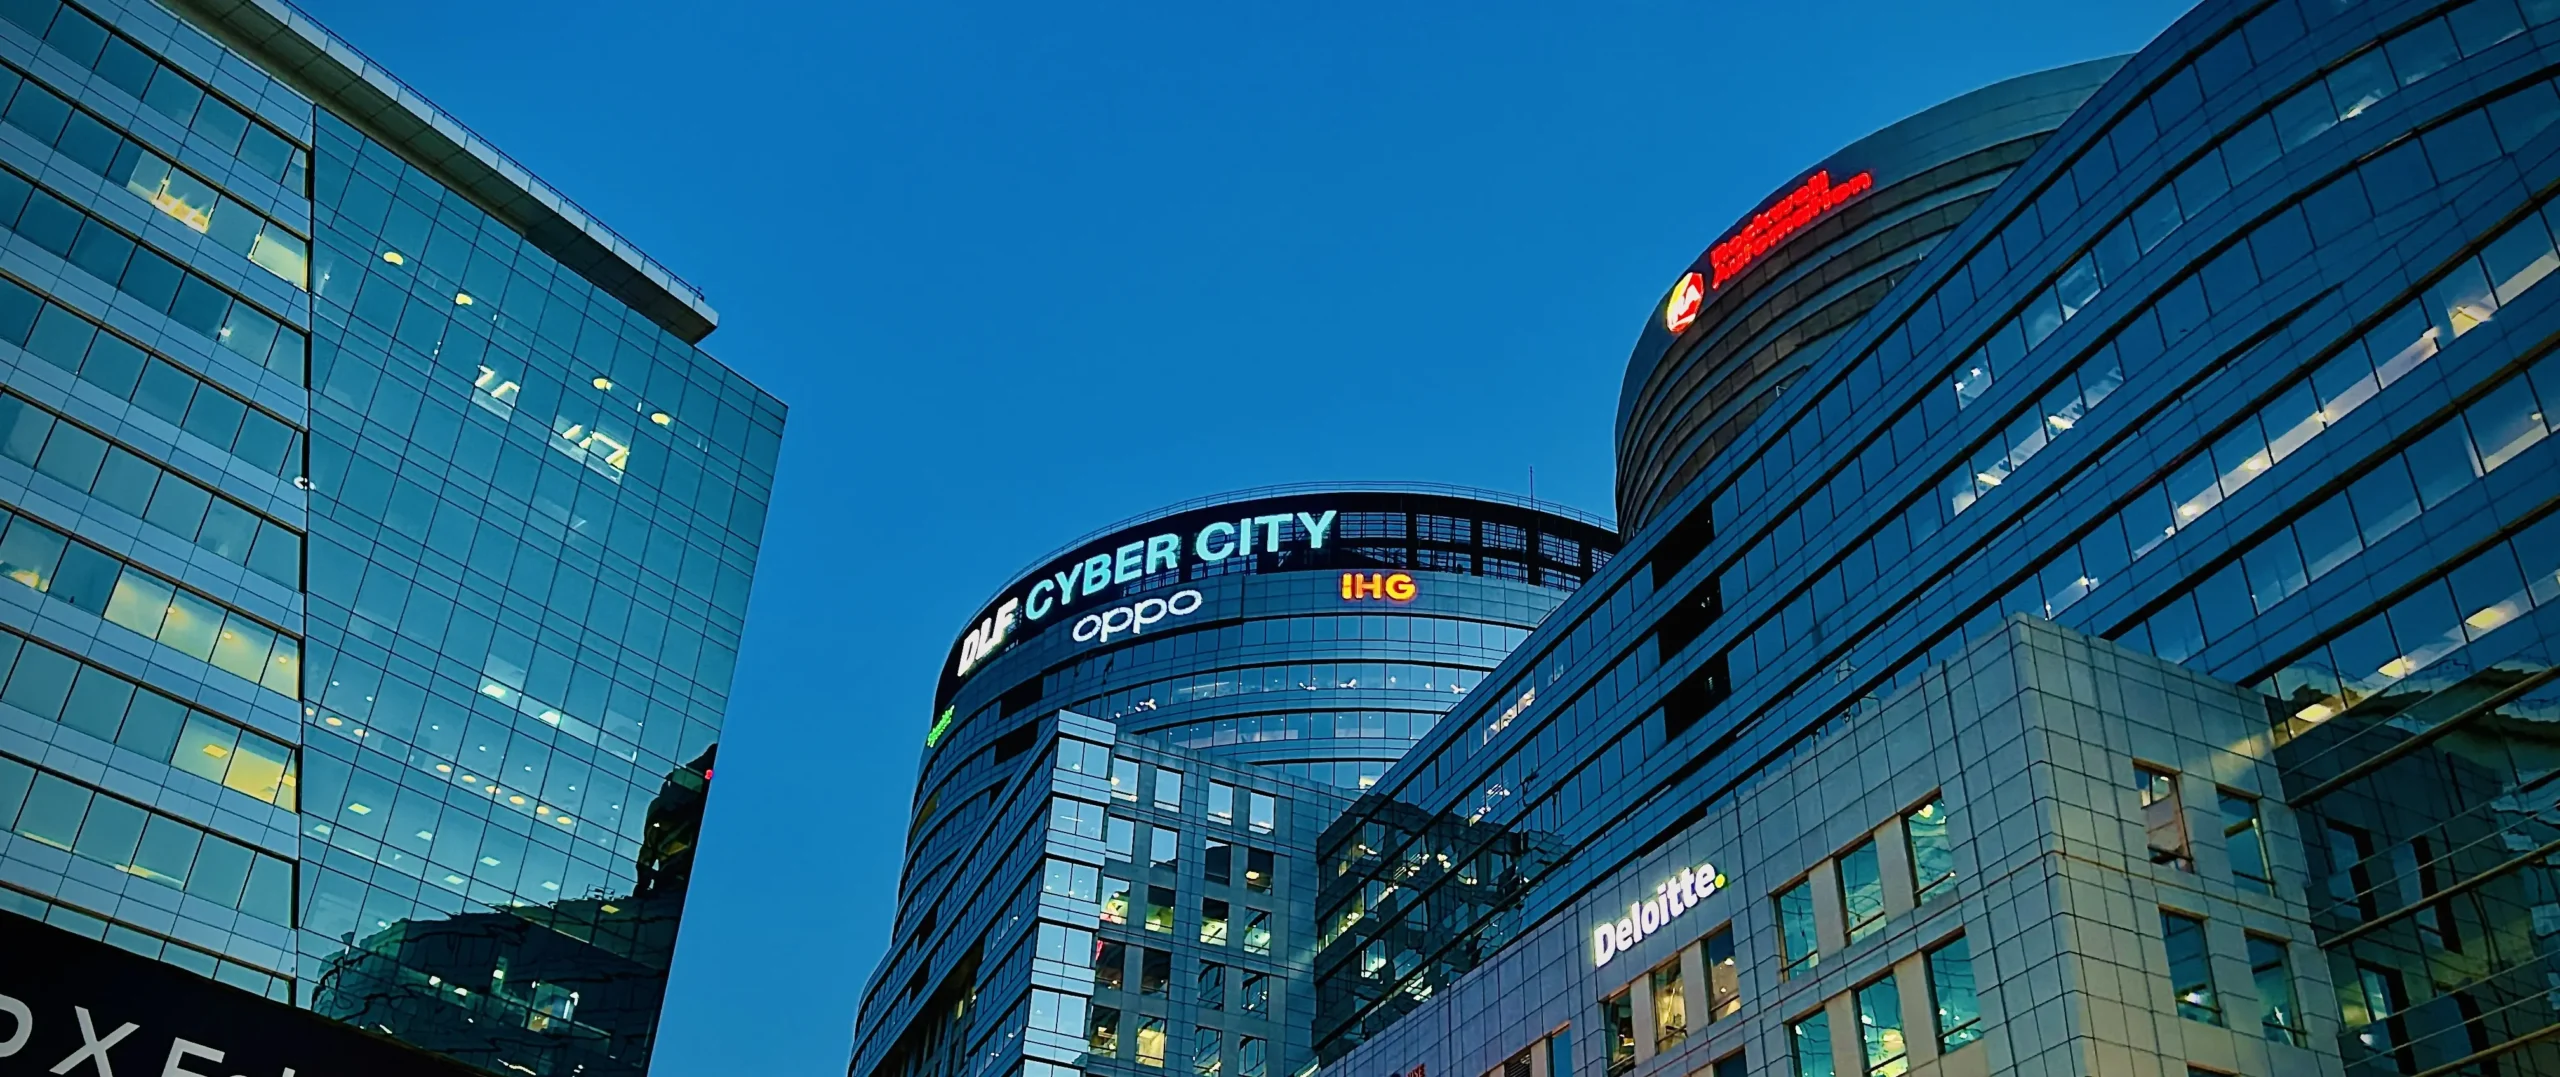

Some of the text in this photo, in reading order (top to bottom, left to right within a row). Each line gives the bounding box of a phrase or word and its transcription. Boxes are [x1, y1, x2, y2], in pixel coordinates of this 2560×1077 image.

[1710, 169, 1830, 267] Rockwell
[1712, 172, 1873, 290] Automation
[957, 510, 1337, 677] DLF CYBER CITY
[1071, 589, 1203, 643] oppo
[1341, 572, 1417, 601] IHG
[1593, 862, 1726, 968] Deloitte.
